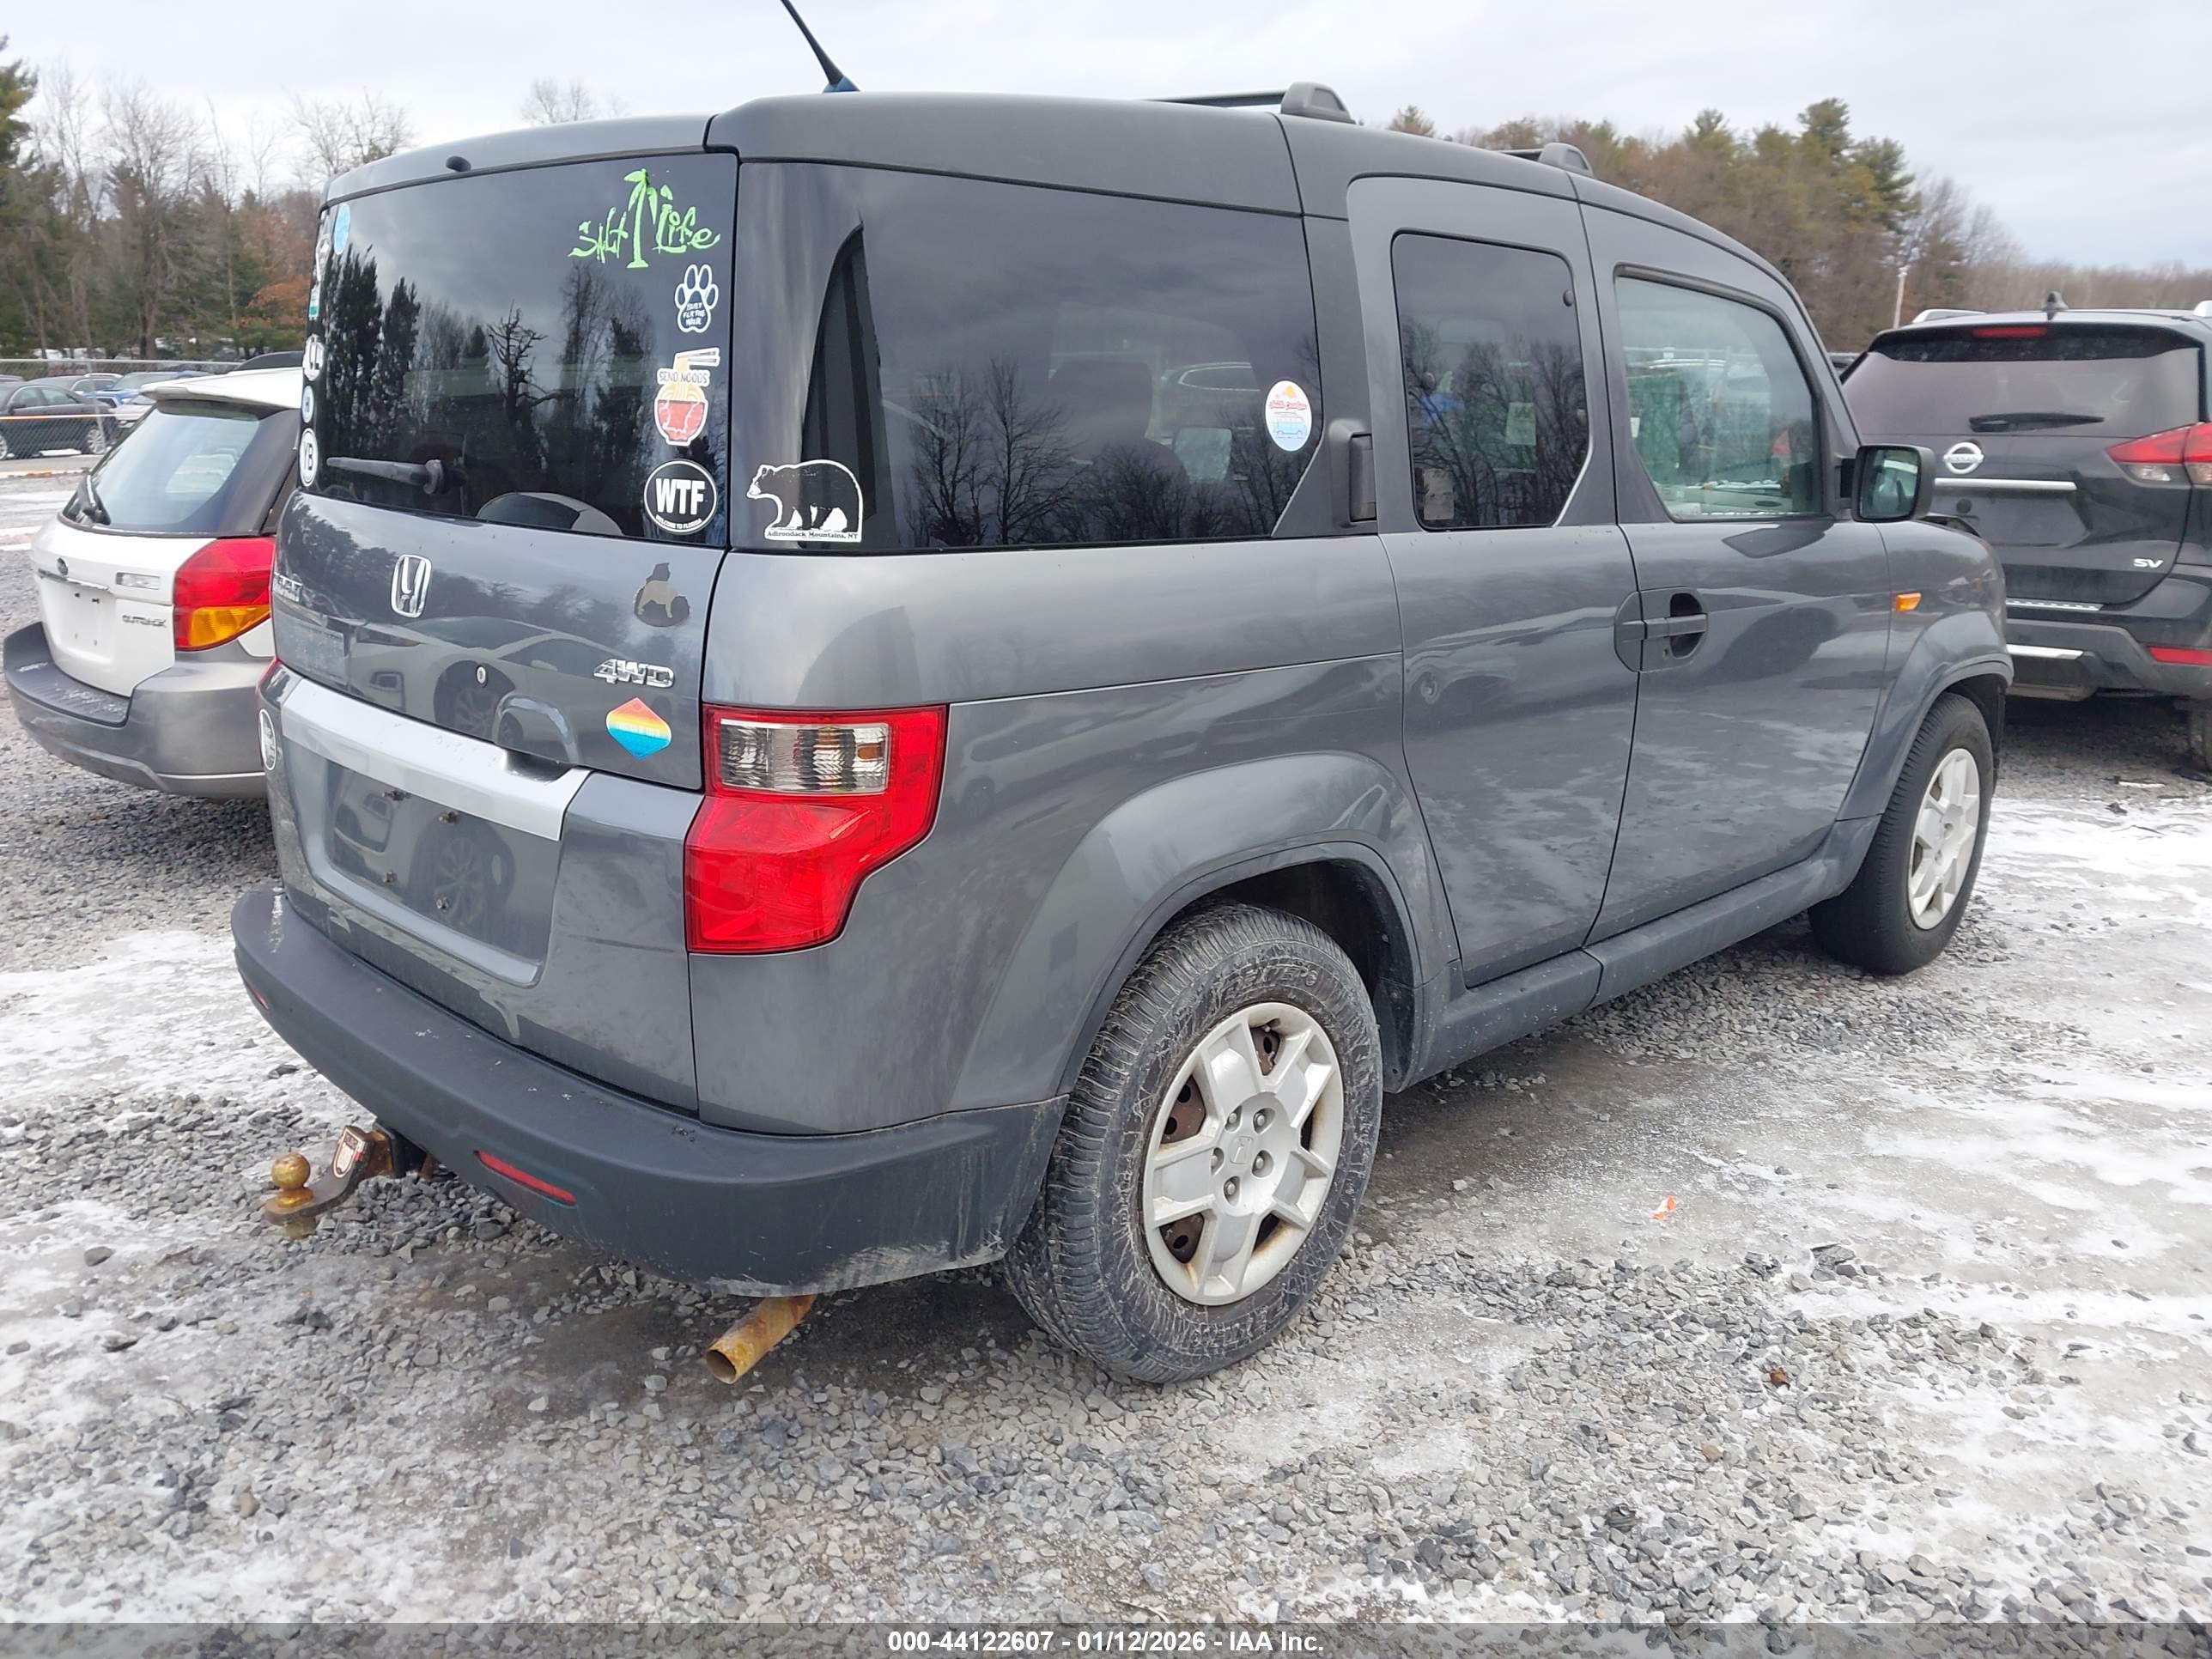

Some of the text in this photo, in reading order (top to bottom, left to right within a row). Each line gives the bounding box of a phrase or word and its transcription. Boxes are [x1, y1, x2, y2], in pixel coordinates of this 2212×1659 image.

[655, 477, 706, 515] WTF
[2133, 558, 2164, 568] SV
[593, 659, 674, 688] 4WD
